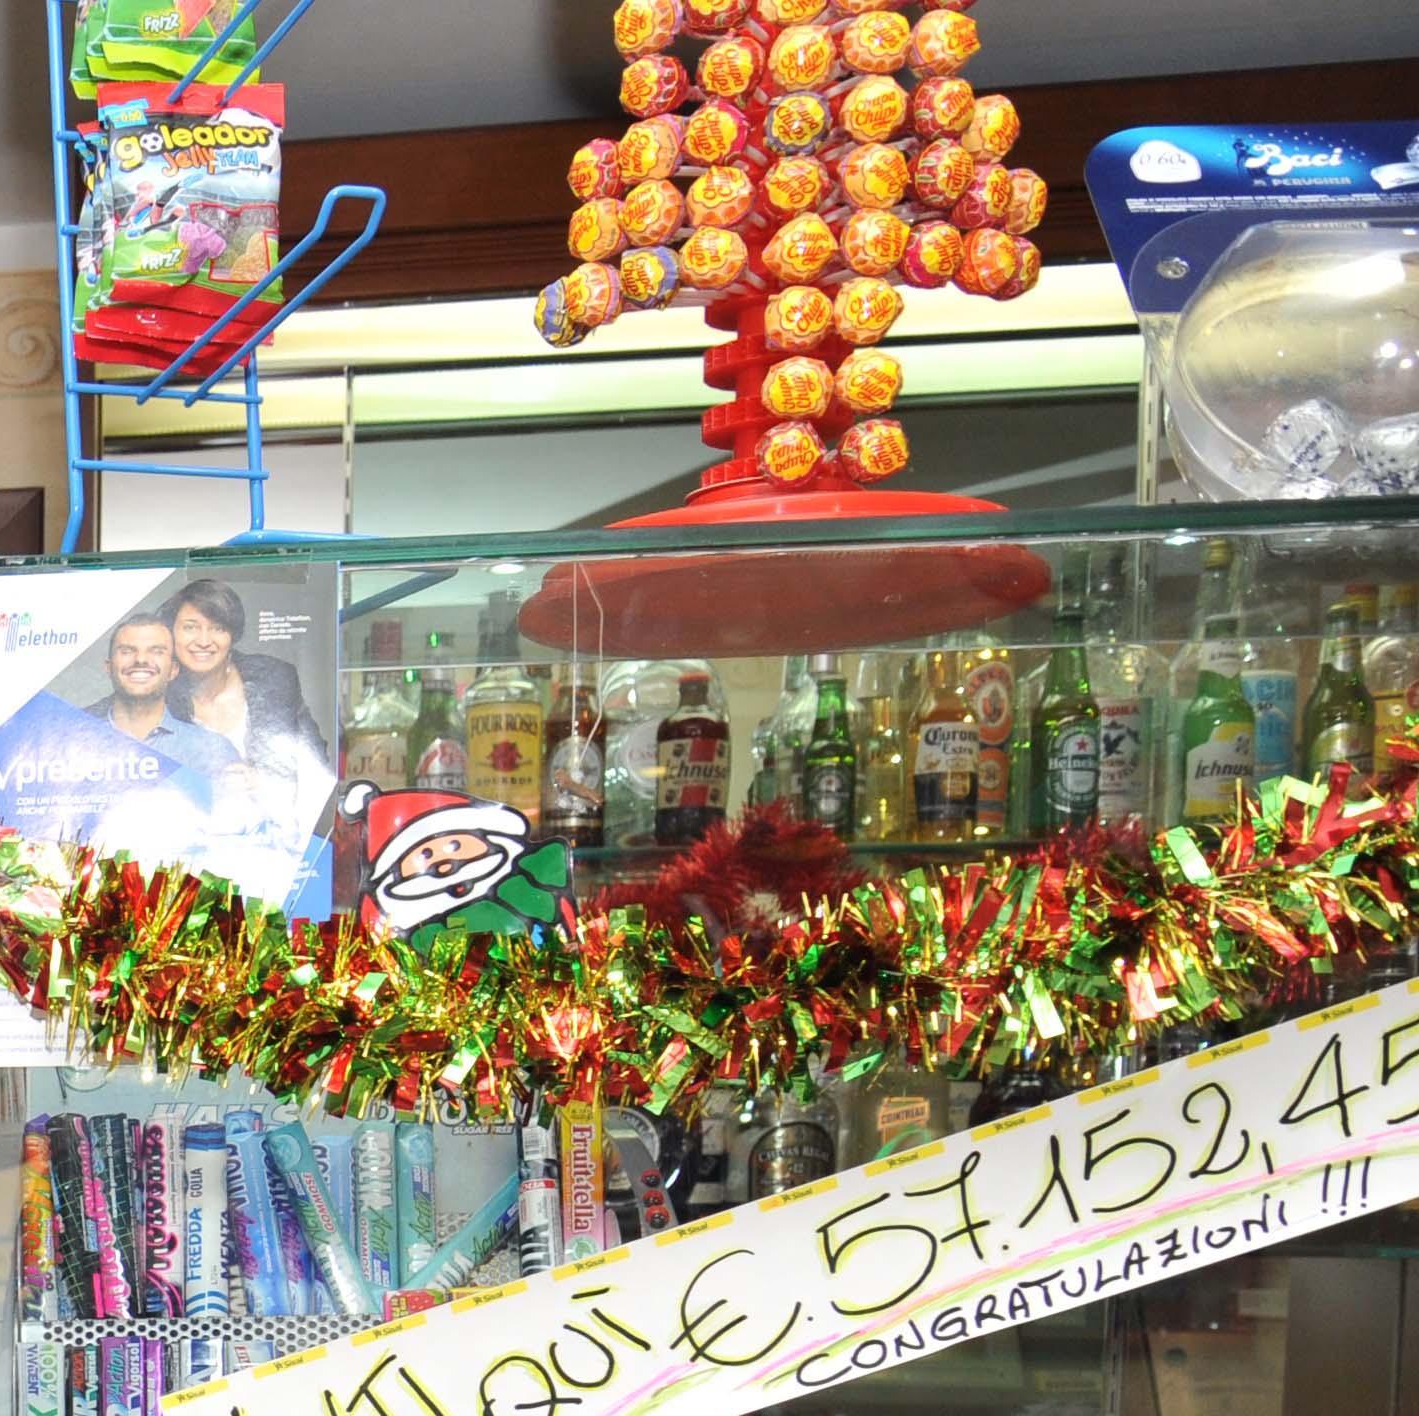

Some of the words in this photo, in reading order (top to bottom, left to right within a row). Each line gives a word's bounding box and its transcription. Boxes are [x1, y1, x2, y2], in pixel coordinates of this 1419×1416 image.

[144, 13, 179, 32] FRIZZ
[116, 124, 275, 168] goleador
[216, 150, 259, 168] TEAM
[1244, 144, 1343, 176] Baci
[1272, 176, 1351, 187] PERUGINA
[140, 250, 181, 271] FRIZZ
[16, 754, 160, 793] presente
[190, 1167, 204, 1198] GOLIA
[187, 1208, 203, 1281] FREDDA
[795, 1193, 1290, 1387] CONGRATULAZIONI
[127, 1342, 142, 1397] Vigorsol
